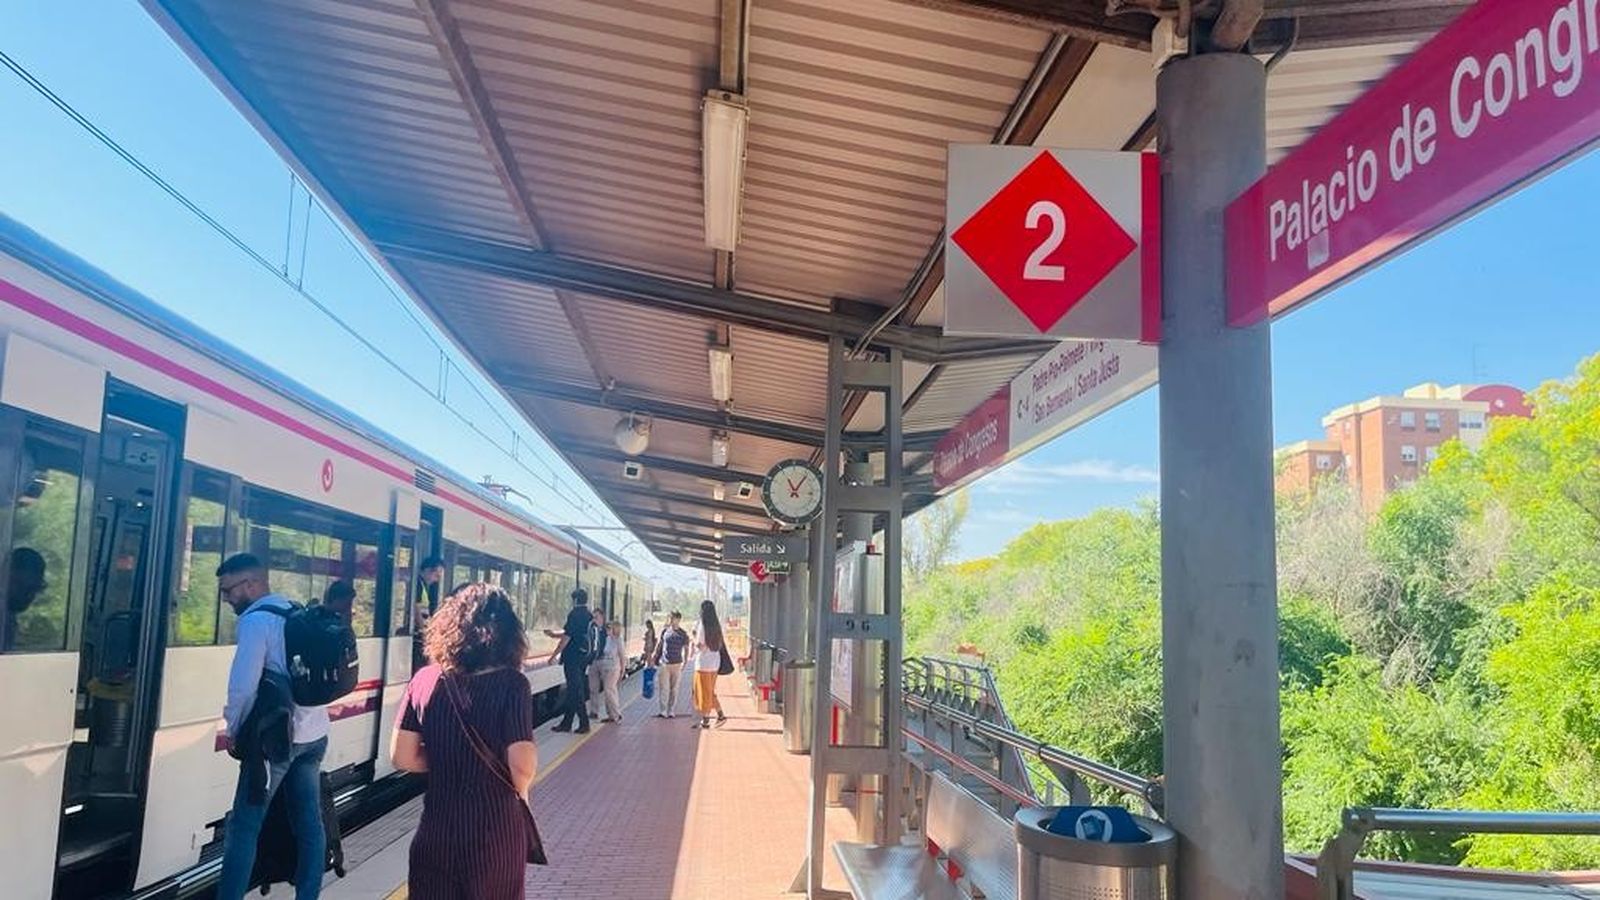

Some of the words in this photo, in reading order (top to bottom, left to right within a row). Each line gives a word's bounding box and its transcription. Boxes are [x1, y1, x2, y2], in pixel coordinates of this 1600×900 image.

[1269, 145, 1378, 262] Palacio
[1389, 103, 1437, 182] de
[1022, 200, 1066, 281] 2
[1077, 367, 1099, 397] Santa
[1099, 353, 1121, 386] Justa
[740, 543, 772, 554] Salida
